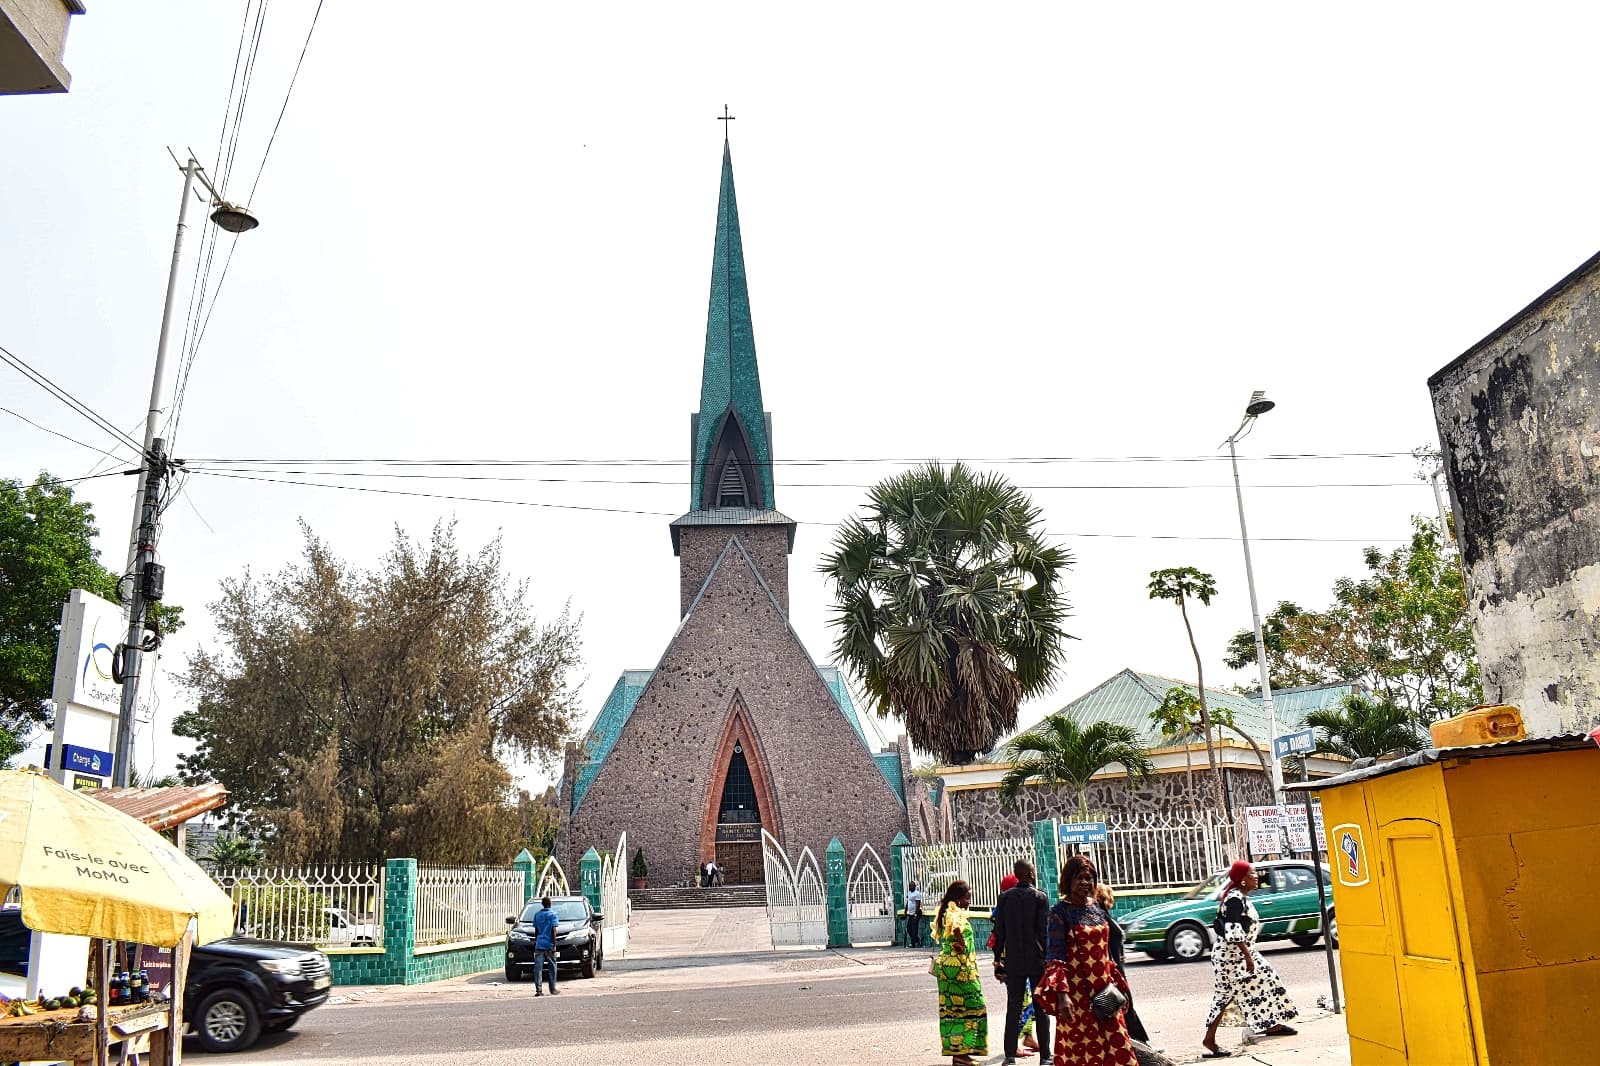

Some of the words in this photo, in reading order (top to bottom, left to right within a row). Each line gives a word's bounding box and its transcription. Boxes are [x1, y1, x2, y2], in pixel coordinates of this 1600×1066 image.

[75, 778, 97, 788] WESTERN
[42, 846, 104, 865] Fais-le
[108, 858, 150, 874] avec
[76, 866, 129, 884] MoMo
